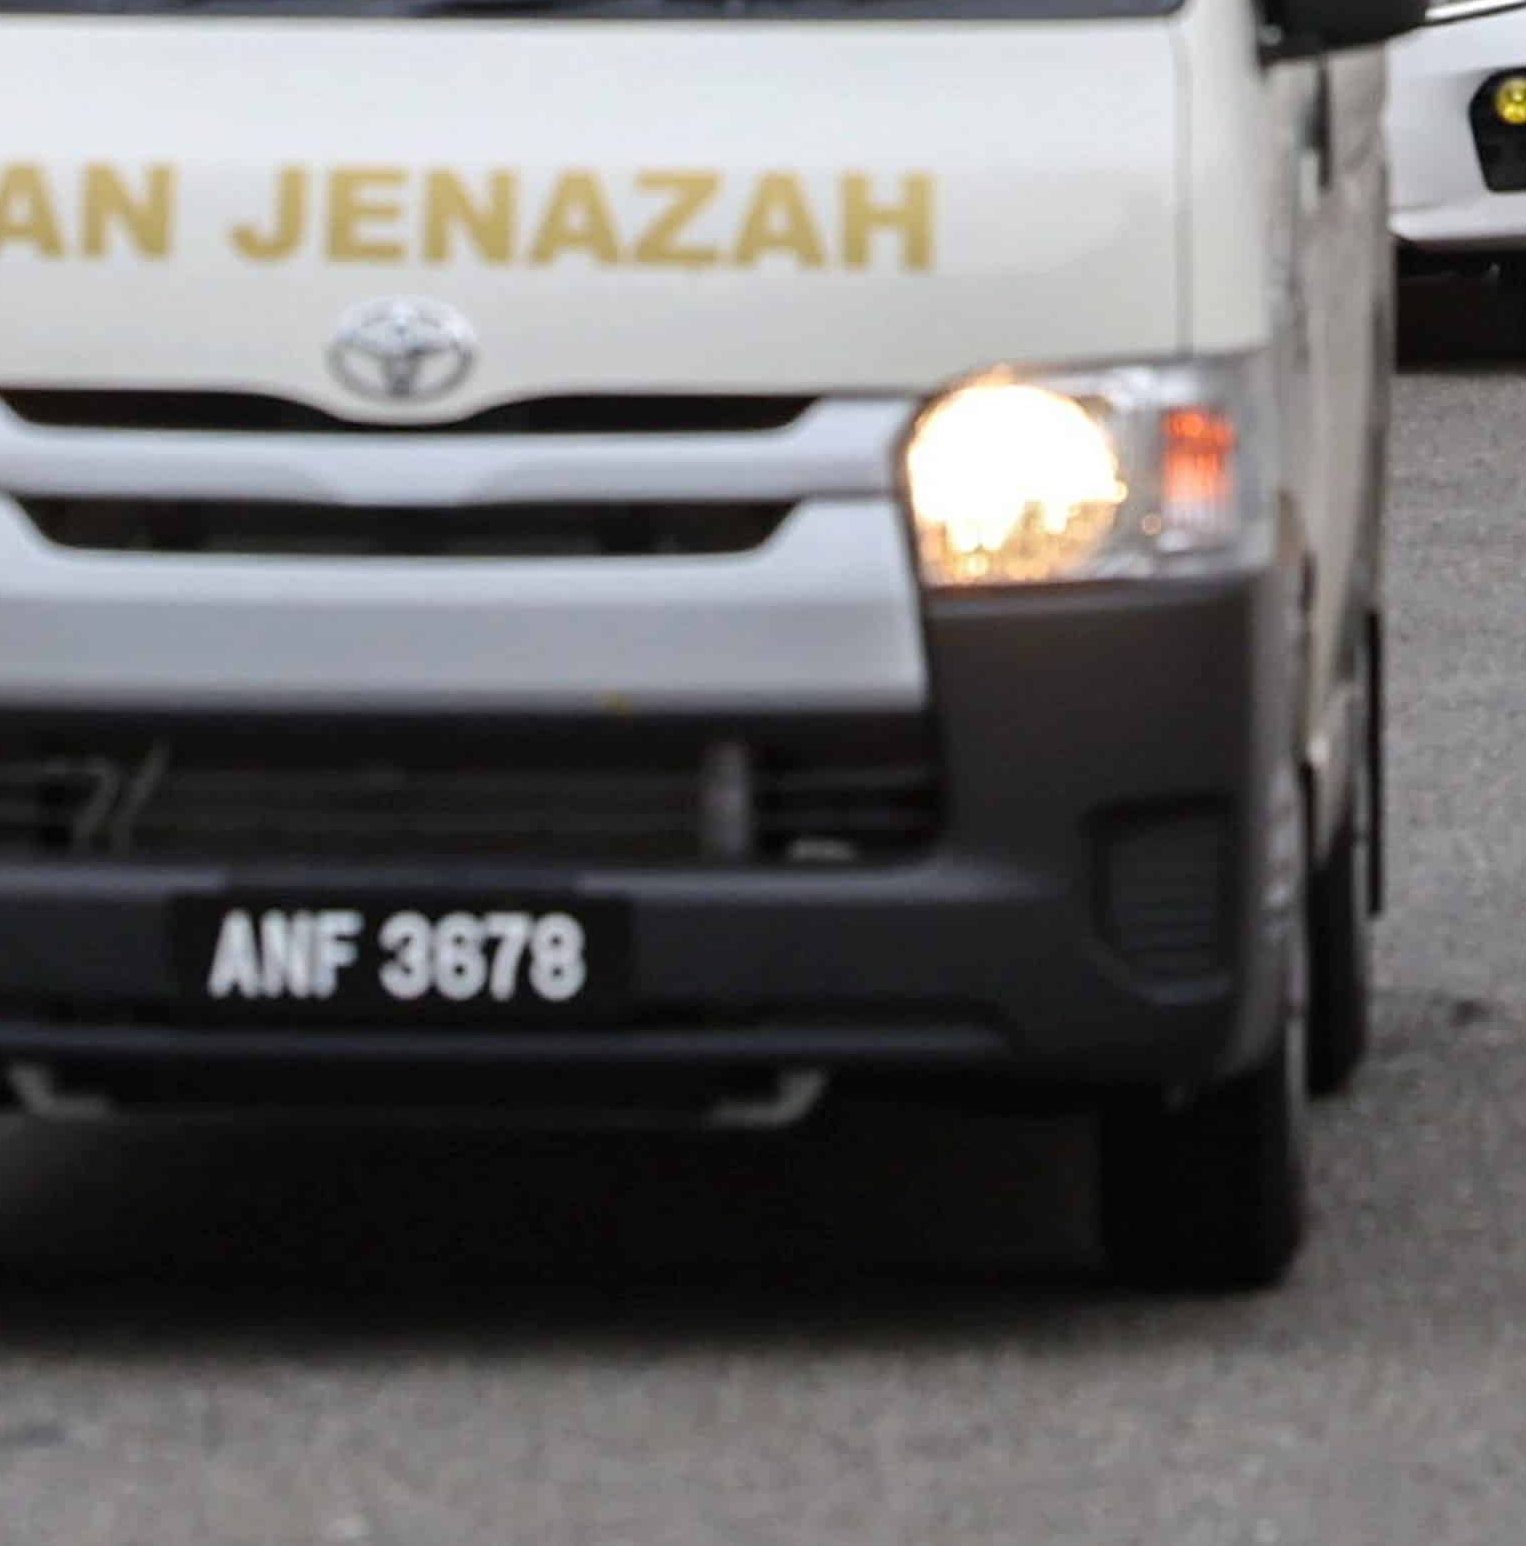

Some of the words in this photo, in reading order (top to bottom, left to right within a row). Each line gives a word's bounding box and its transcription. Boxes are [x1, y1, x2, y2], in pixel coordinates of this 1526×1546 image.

[229, 164, 936, 271] JENAZAH
[208, 909, 364, 999] ANF
[377, 910, 587, 1001] 3678
